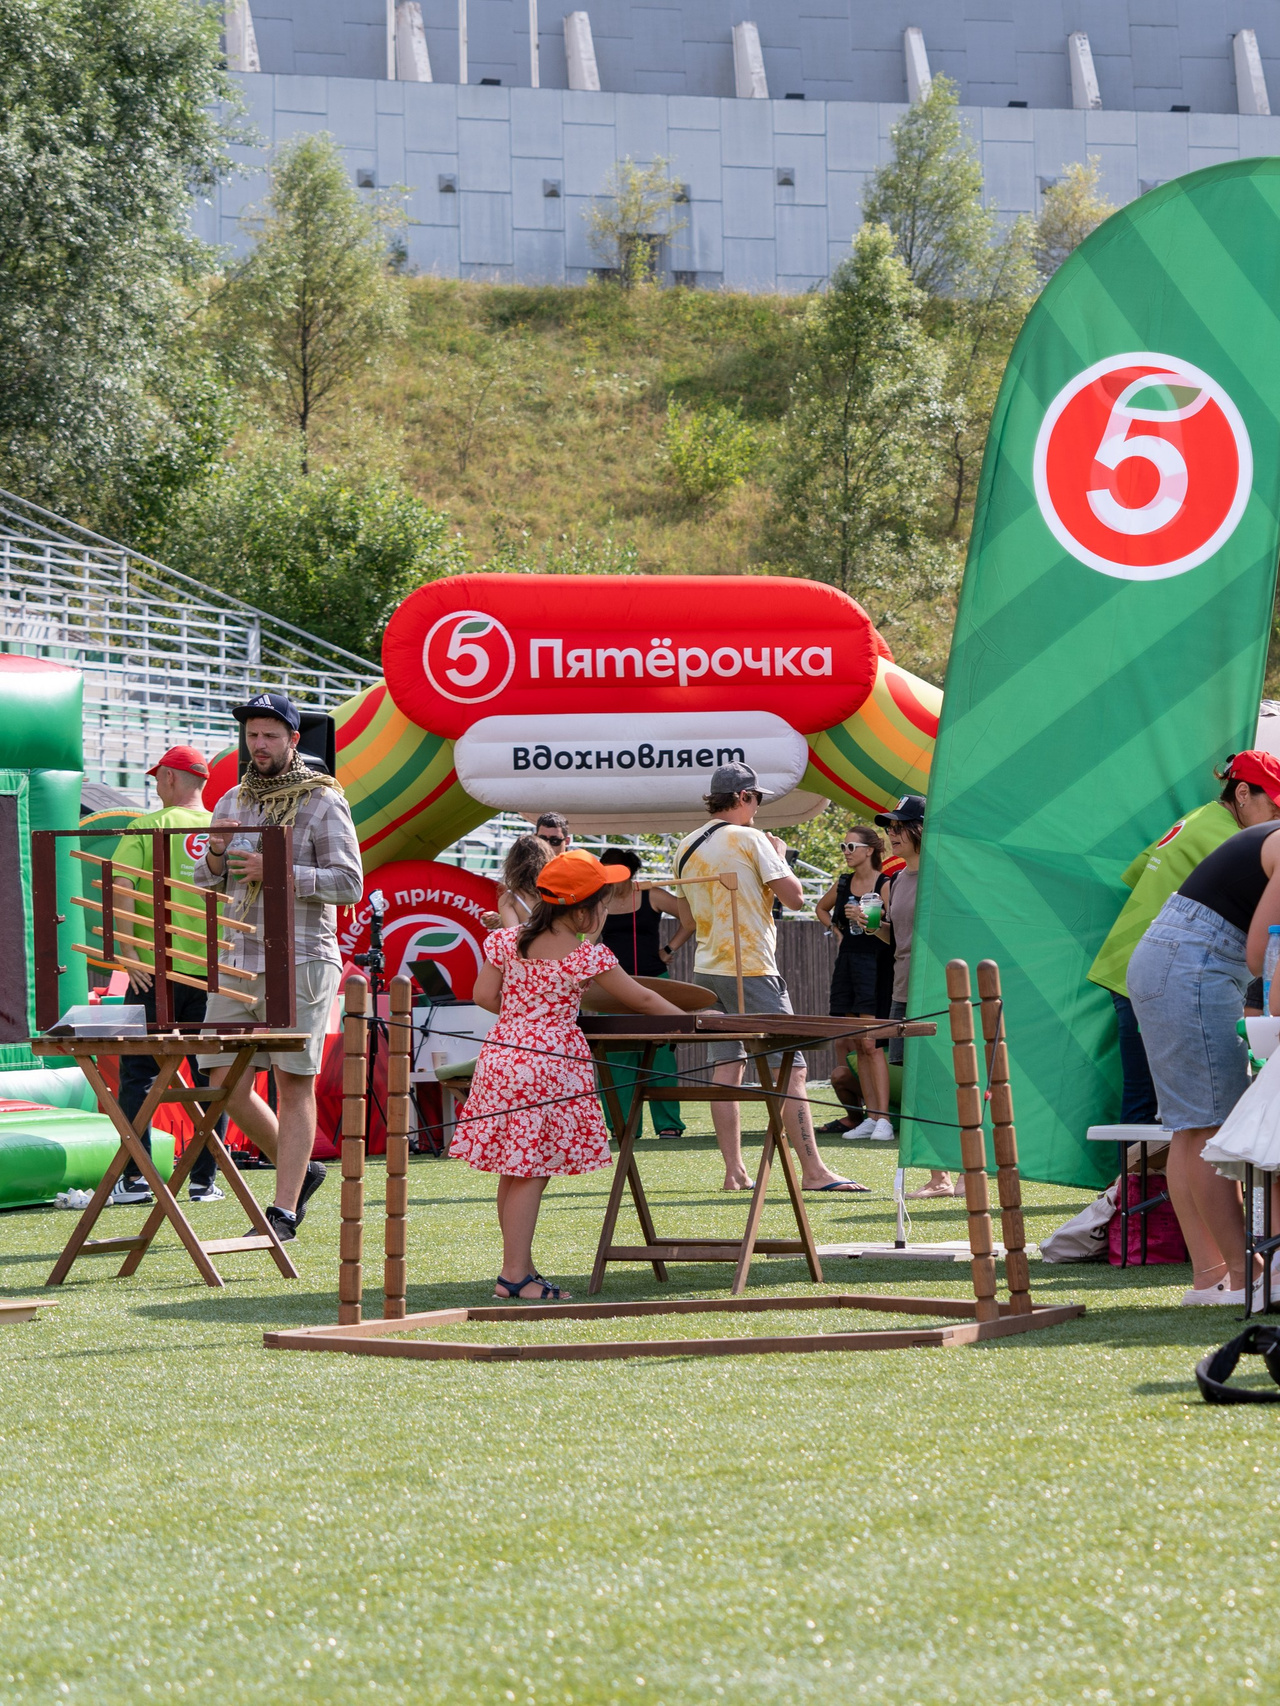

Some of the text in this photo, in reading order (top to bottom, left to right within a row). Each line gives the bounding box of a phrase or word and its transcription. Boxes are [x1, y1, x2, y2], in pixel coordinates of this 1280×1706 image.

[1085, 372, 1212, 536] 5
[444, 617, 833, 688] 5 Пятёрочка
[512, 743, 746, 772] Вдохновляет
